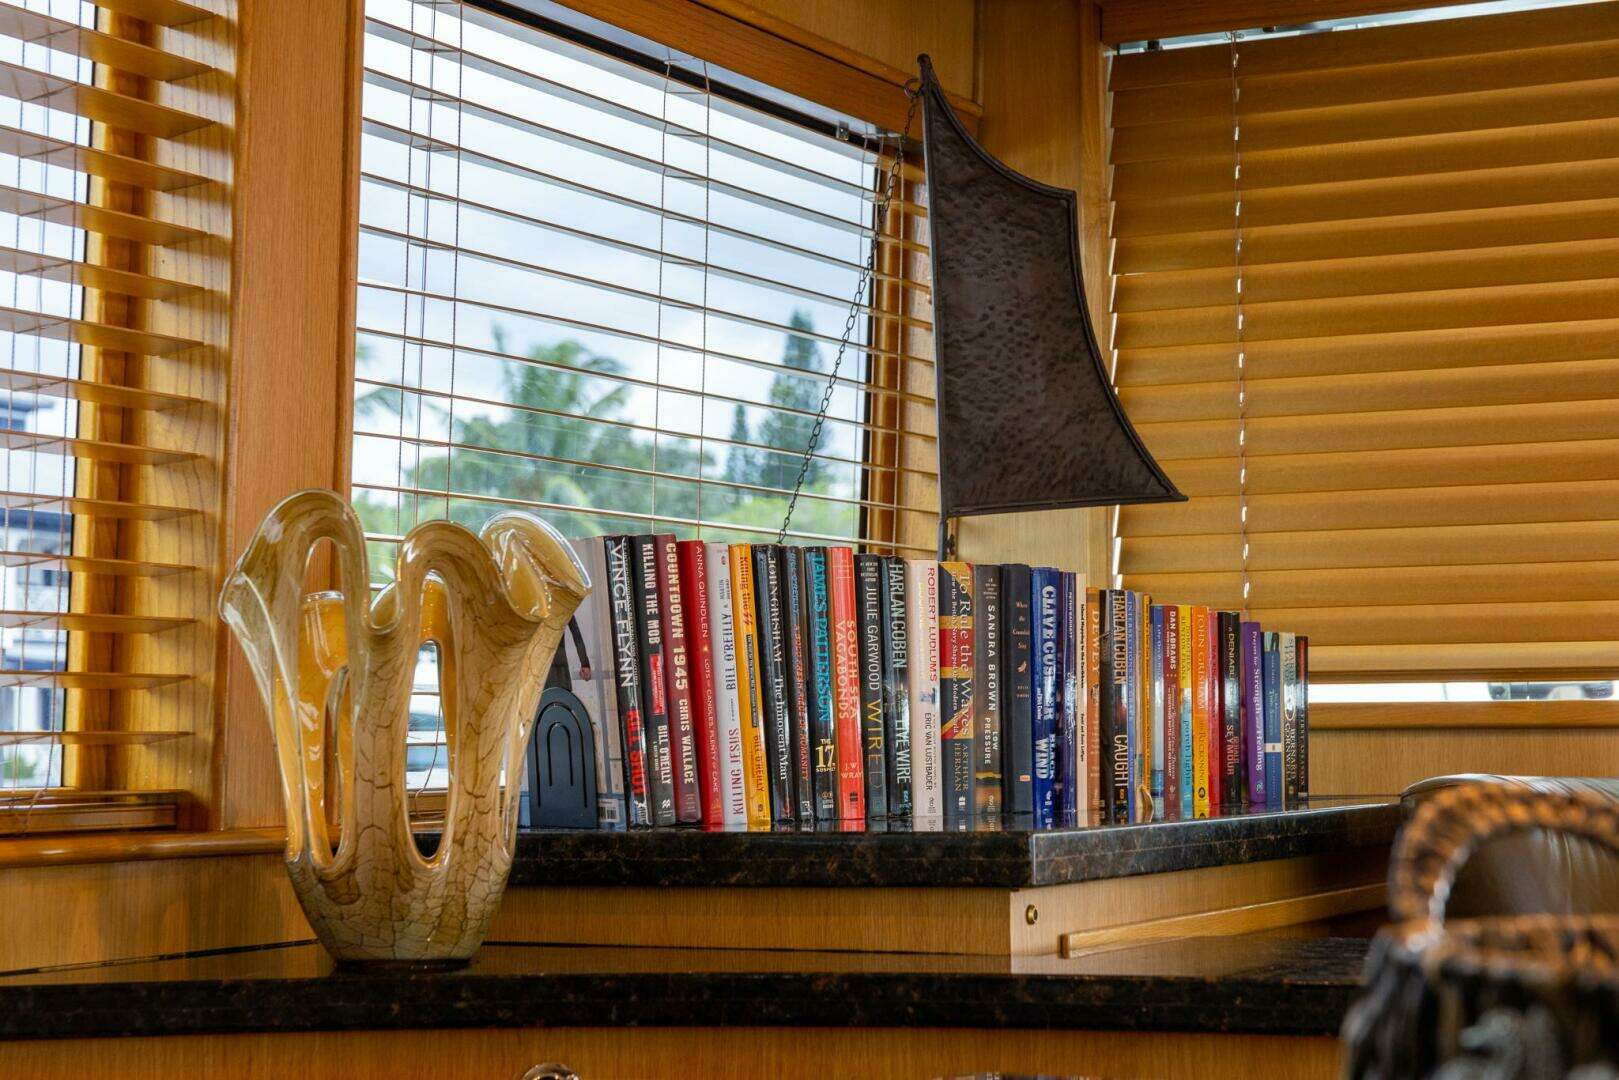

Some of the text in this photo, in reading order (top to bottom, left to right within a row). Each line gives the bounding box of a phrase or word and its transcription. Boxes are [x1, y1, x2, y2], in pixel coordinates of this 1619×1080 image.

[611, 544, 628, 613] VINCE
[642, 544, 660, 644] KILLING THE MOB
[666, 543, 684, 638] COUNTDOWN
[696, 546, 708, 638] ANNA QUINDLEN
[742, 592, 750, 610] the
[927, 568, 936, 621] ROBERT
[769, 558, 783, 662] JOHN GRISHAM
[866, 586, 878, 620] JULIE
[889, 564, 907, 668] HARLAN COBEN
[616, 620, 634, 687] FLYNN
[721, 613, 735, 661] O'REILLY
[812, 555, 831, 721] JAMES PATTERSON
[867, 625, 881, 690] GARWOOD
[960, 575, 972, 736] To Rule the Waves
[1042, 585, 1056, 720] CLIVE CUSER
[1113, 595, 1126, 685] HARLAN COBEN
[674, 646, 688, 690] 1945
[724, 667, 737, 690] BILL
[836, 620, 848, 719] VAGABONDS
[847, 620, 858, 719] SOUTH SEA
[1197, 614, 1206, 709] JOHN GRISHAM
[706, 689, 714, 728] CANDLES,
[988, 664, 996, 711] BROWN
[1253, 668, 1261, 713] Strength
[627, 709, 642, 744] KILL
[680, 699, 690, 731] CHRIS
[775, 676, 788, 780] The Innocent Man
[895, 720, 910, 748] LIVE
[924, 713, 933, 729] ERIC
[925, 732, 933, 745] VAN
[658, 725, 671, 784] BILL O'REILLY
[682, 736, 694, 784] WALLACE
[728, 729, 739, 764] JESUS
[800, 734, 808, 781] HUMANITY
[867, 698, 883, 788] WIRED
[896, 749, 911, 784] WIRE
[1036, 738, 1049, 779] WIND
[1114, 734, 1128, 788] CAUGHT
[1224, 725, 1234, 775] SEYMOUR
[629, 751, 647, 795] SHOT
[755, 756, 765, 792] O'REILLY
[925, 748, 935, 790] LUSTBADER
[954, 743, 962, 792] HERMAN
[731, 770, 744, 815] KILLING
